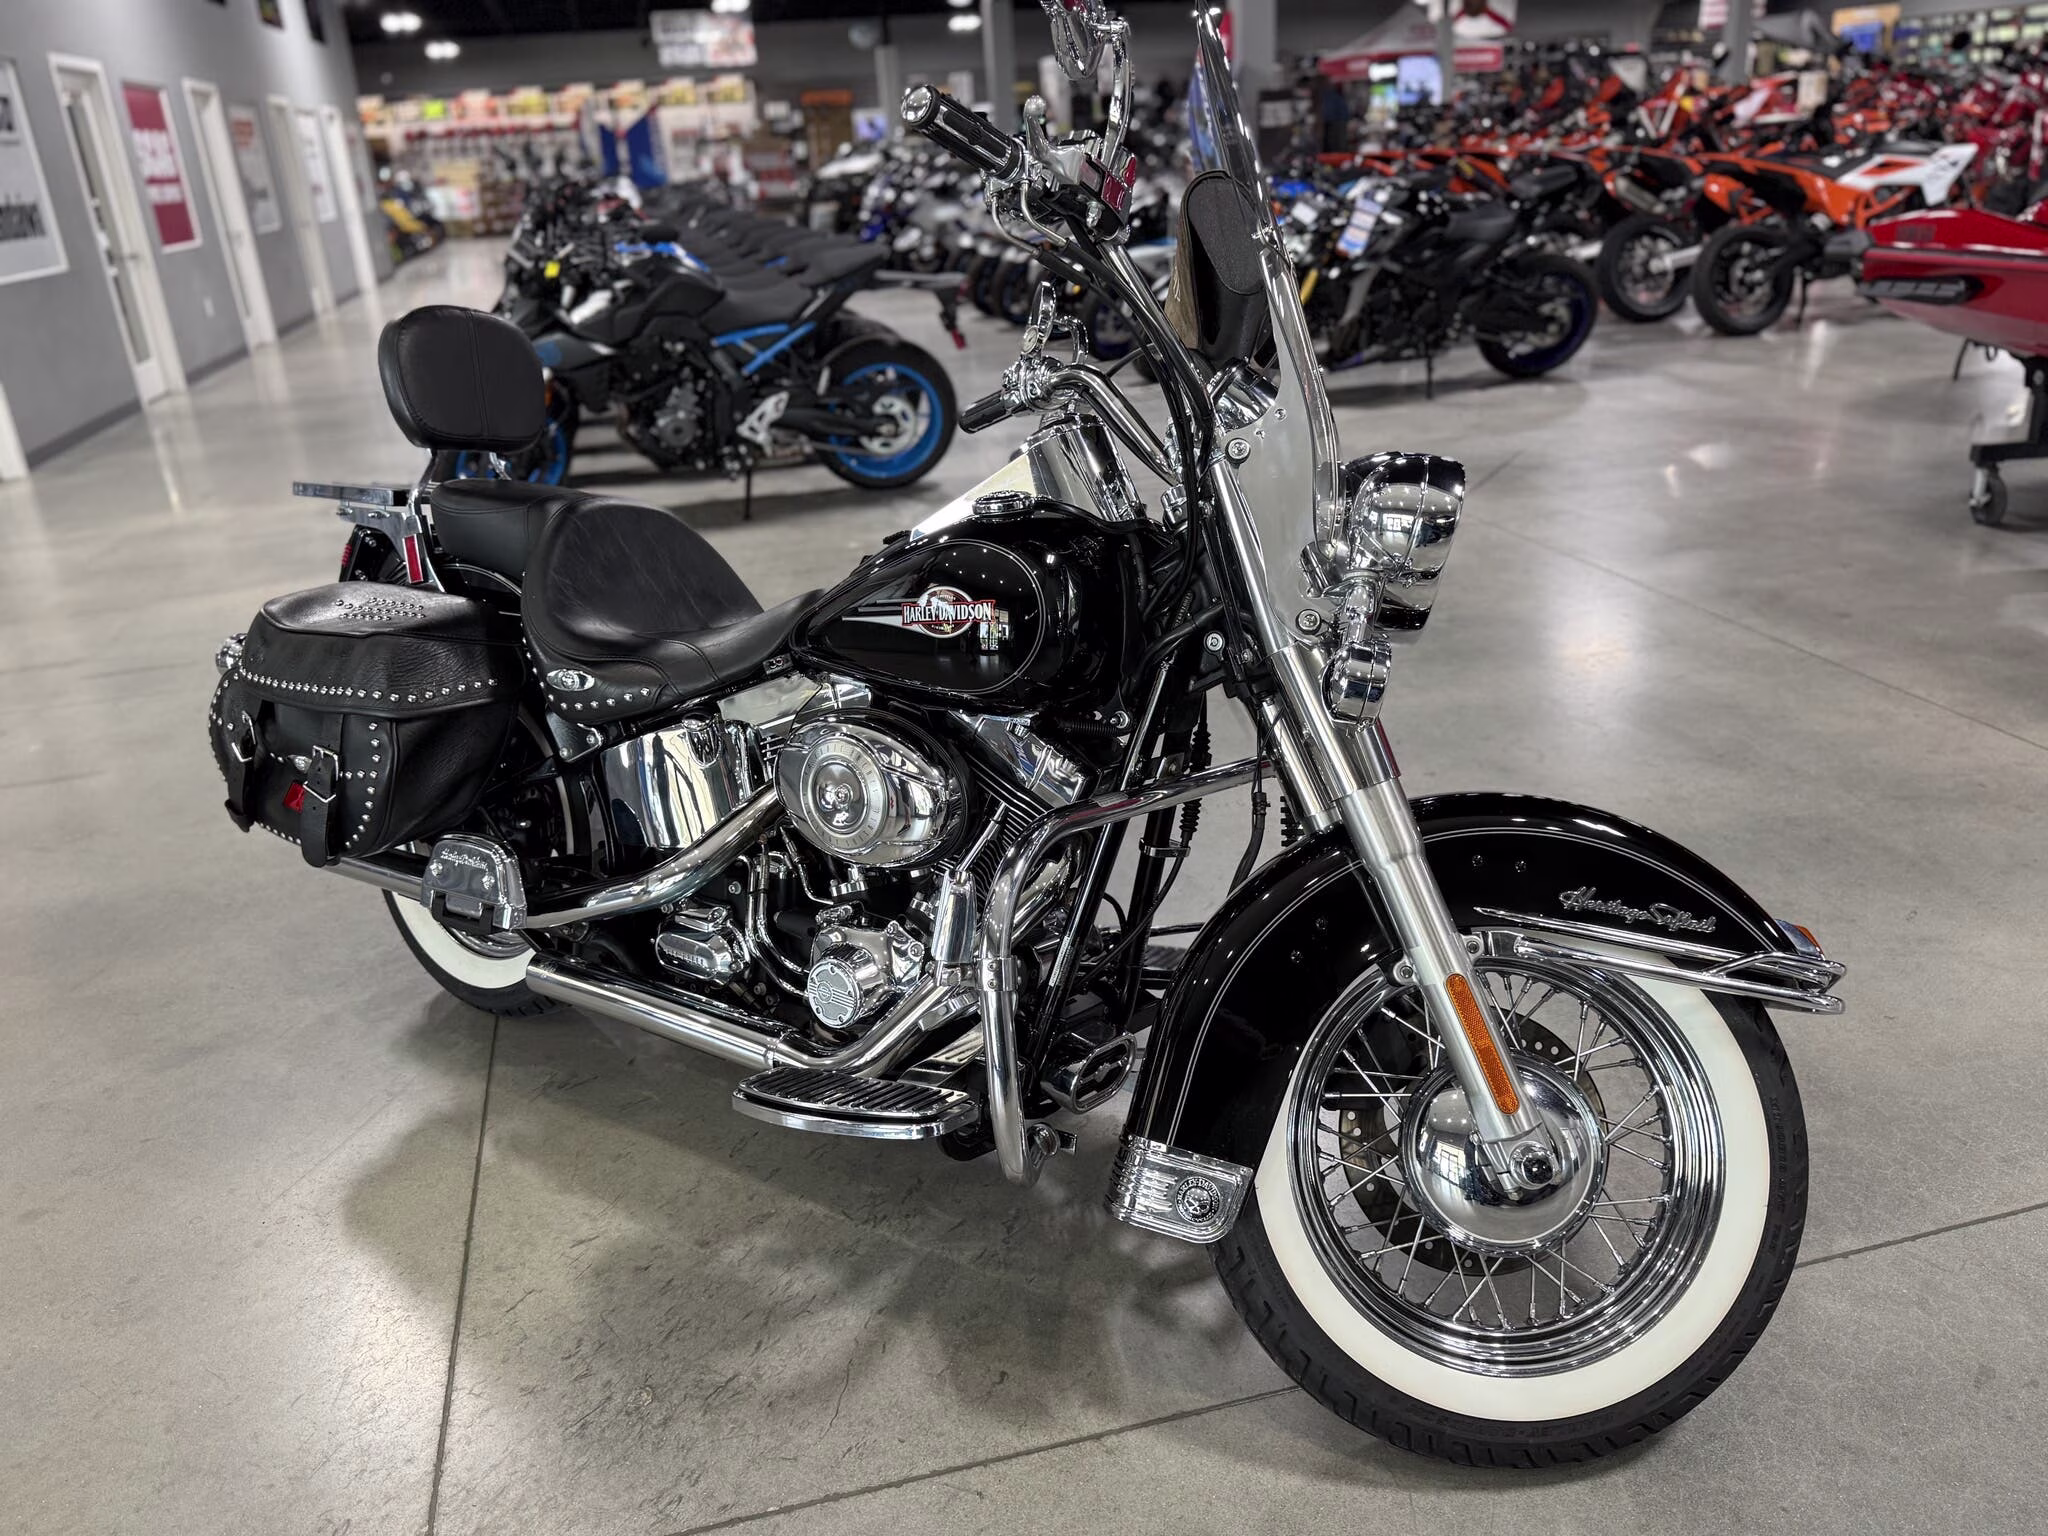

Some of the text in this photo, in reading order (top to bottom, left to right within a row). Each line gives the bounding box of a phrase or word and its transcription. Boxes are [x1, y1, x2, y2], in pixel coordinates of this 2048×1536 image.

[903, 601, 992, 624] HARLEY-DAVIDSON
[1559, 886, 1717, 932] Heritage Softail
